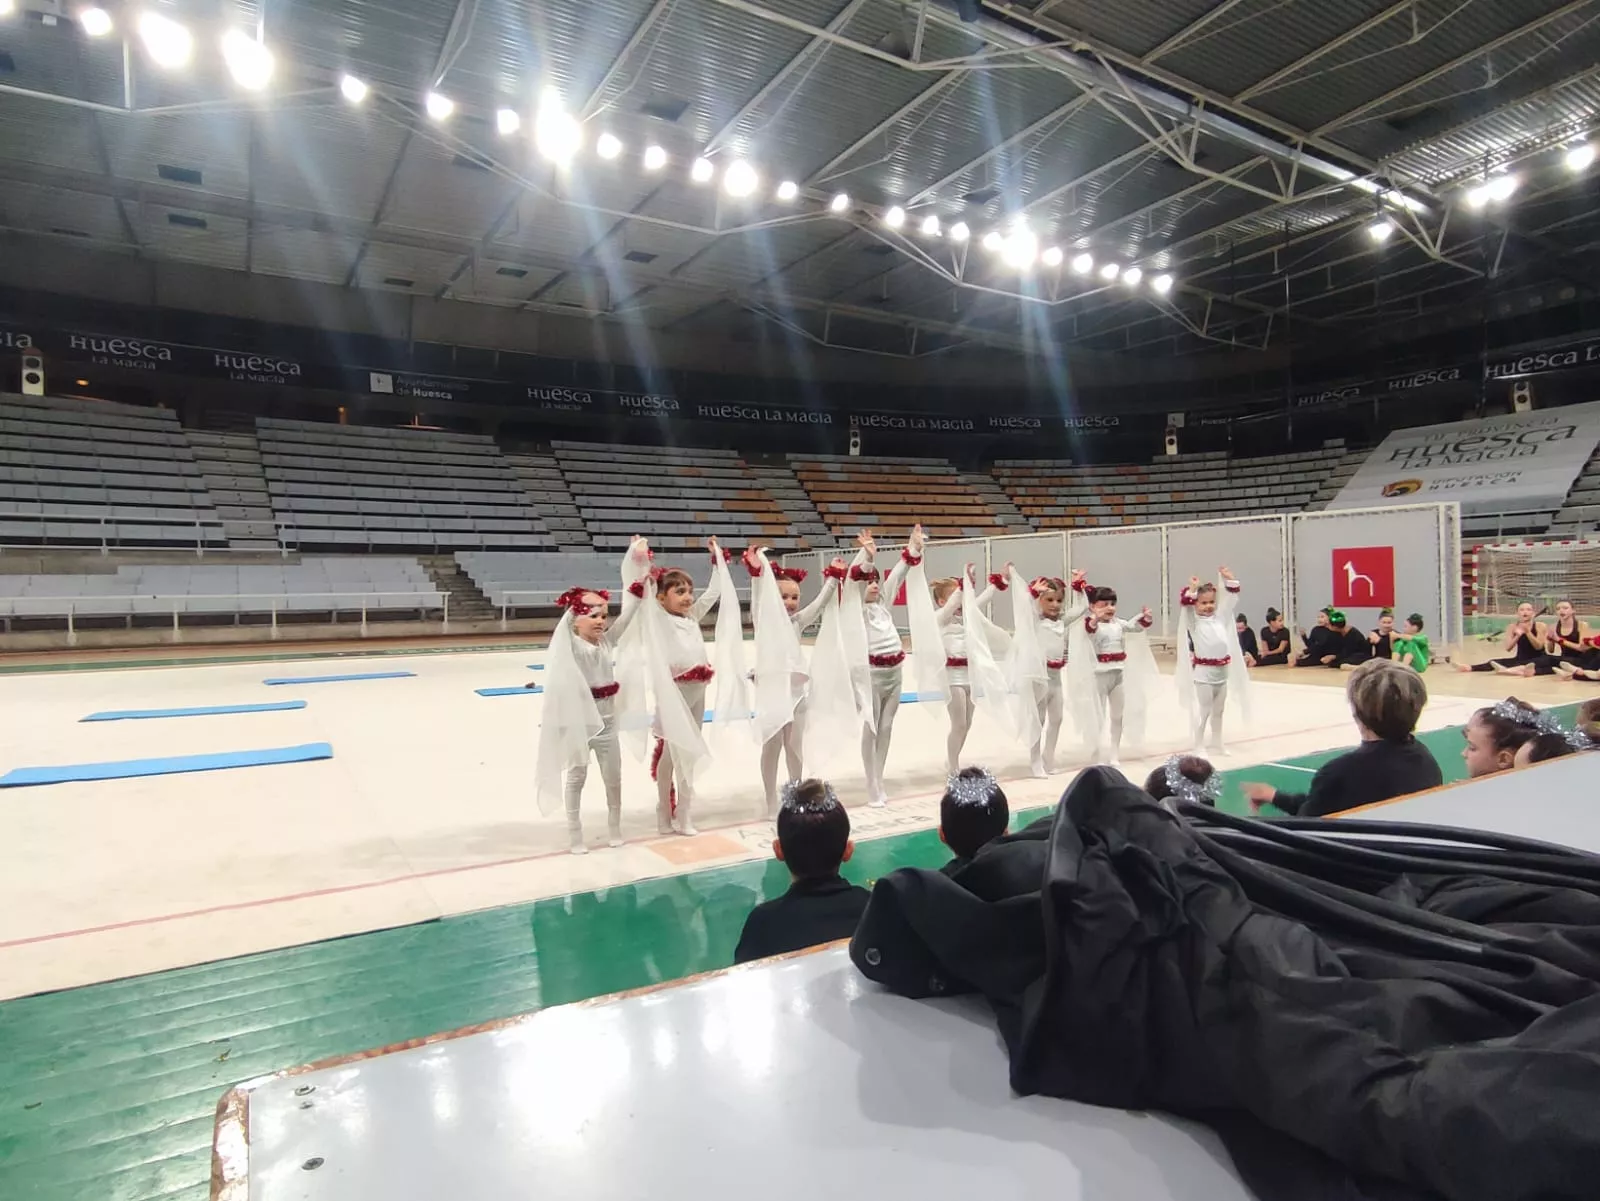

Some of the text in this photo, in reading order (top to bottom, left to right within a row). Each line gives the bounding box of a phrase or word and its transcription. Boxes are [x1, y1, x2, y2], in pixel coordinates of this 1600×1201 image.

[70, 335, 172, 360] Huesca
[215, 354, 301, 376] Huesca
[1485, 351, 1578, 377] Huesca
[1388, 369, 1460, 390] Huesca
[412, 387, 453, 400] Huesca
[527, 387, 592, 403] Huesca
[619, 395, 680, 410] Huesca
[698, 405, 760, 419] Huesca
[765, 409, 782, 421] La
[849, 415, 906, 428] Huesca
[910, 418, 926, 428] La
[989, 416, 1042, 428] Huesca
[1064, 416, 1120, 428] Huesca
[1389, 425, 1578, 461] Huesca
